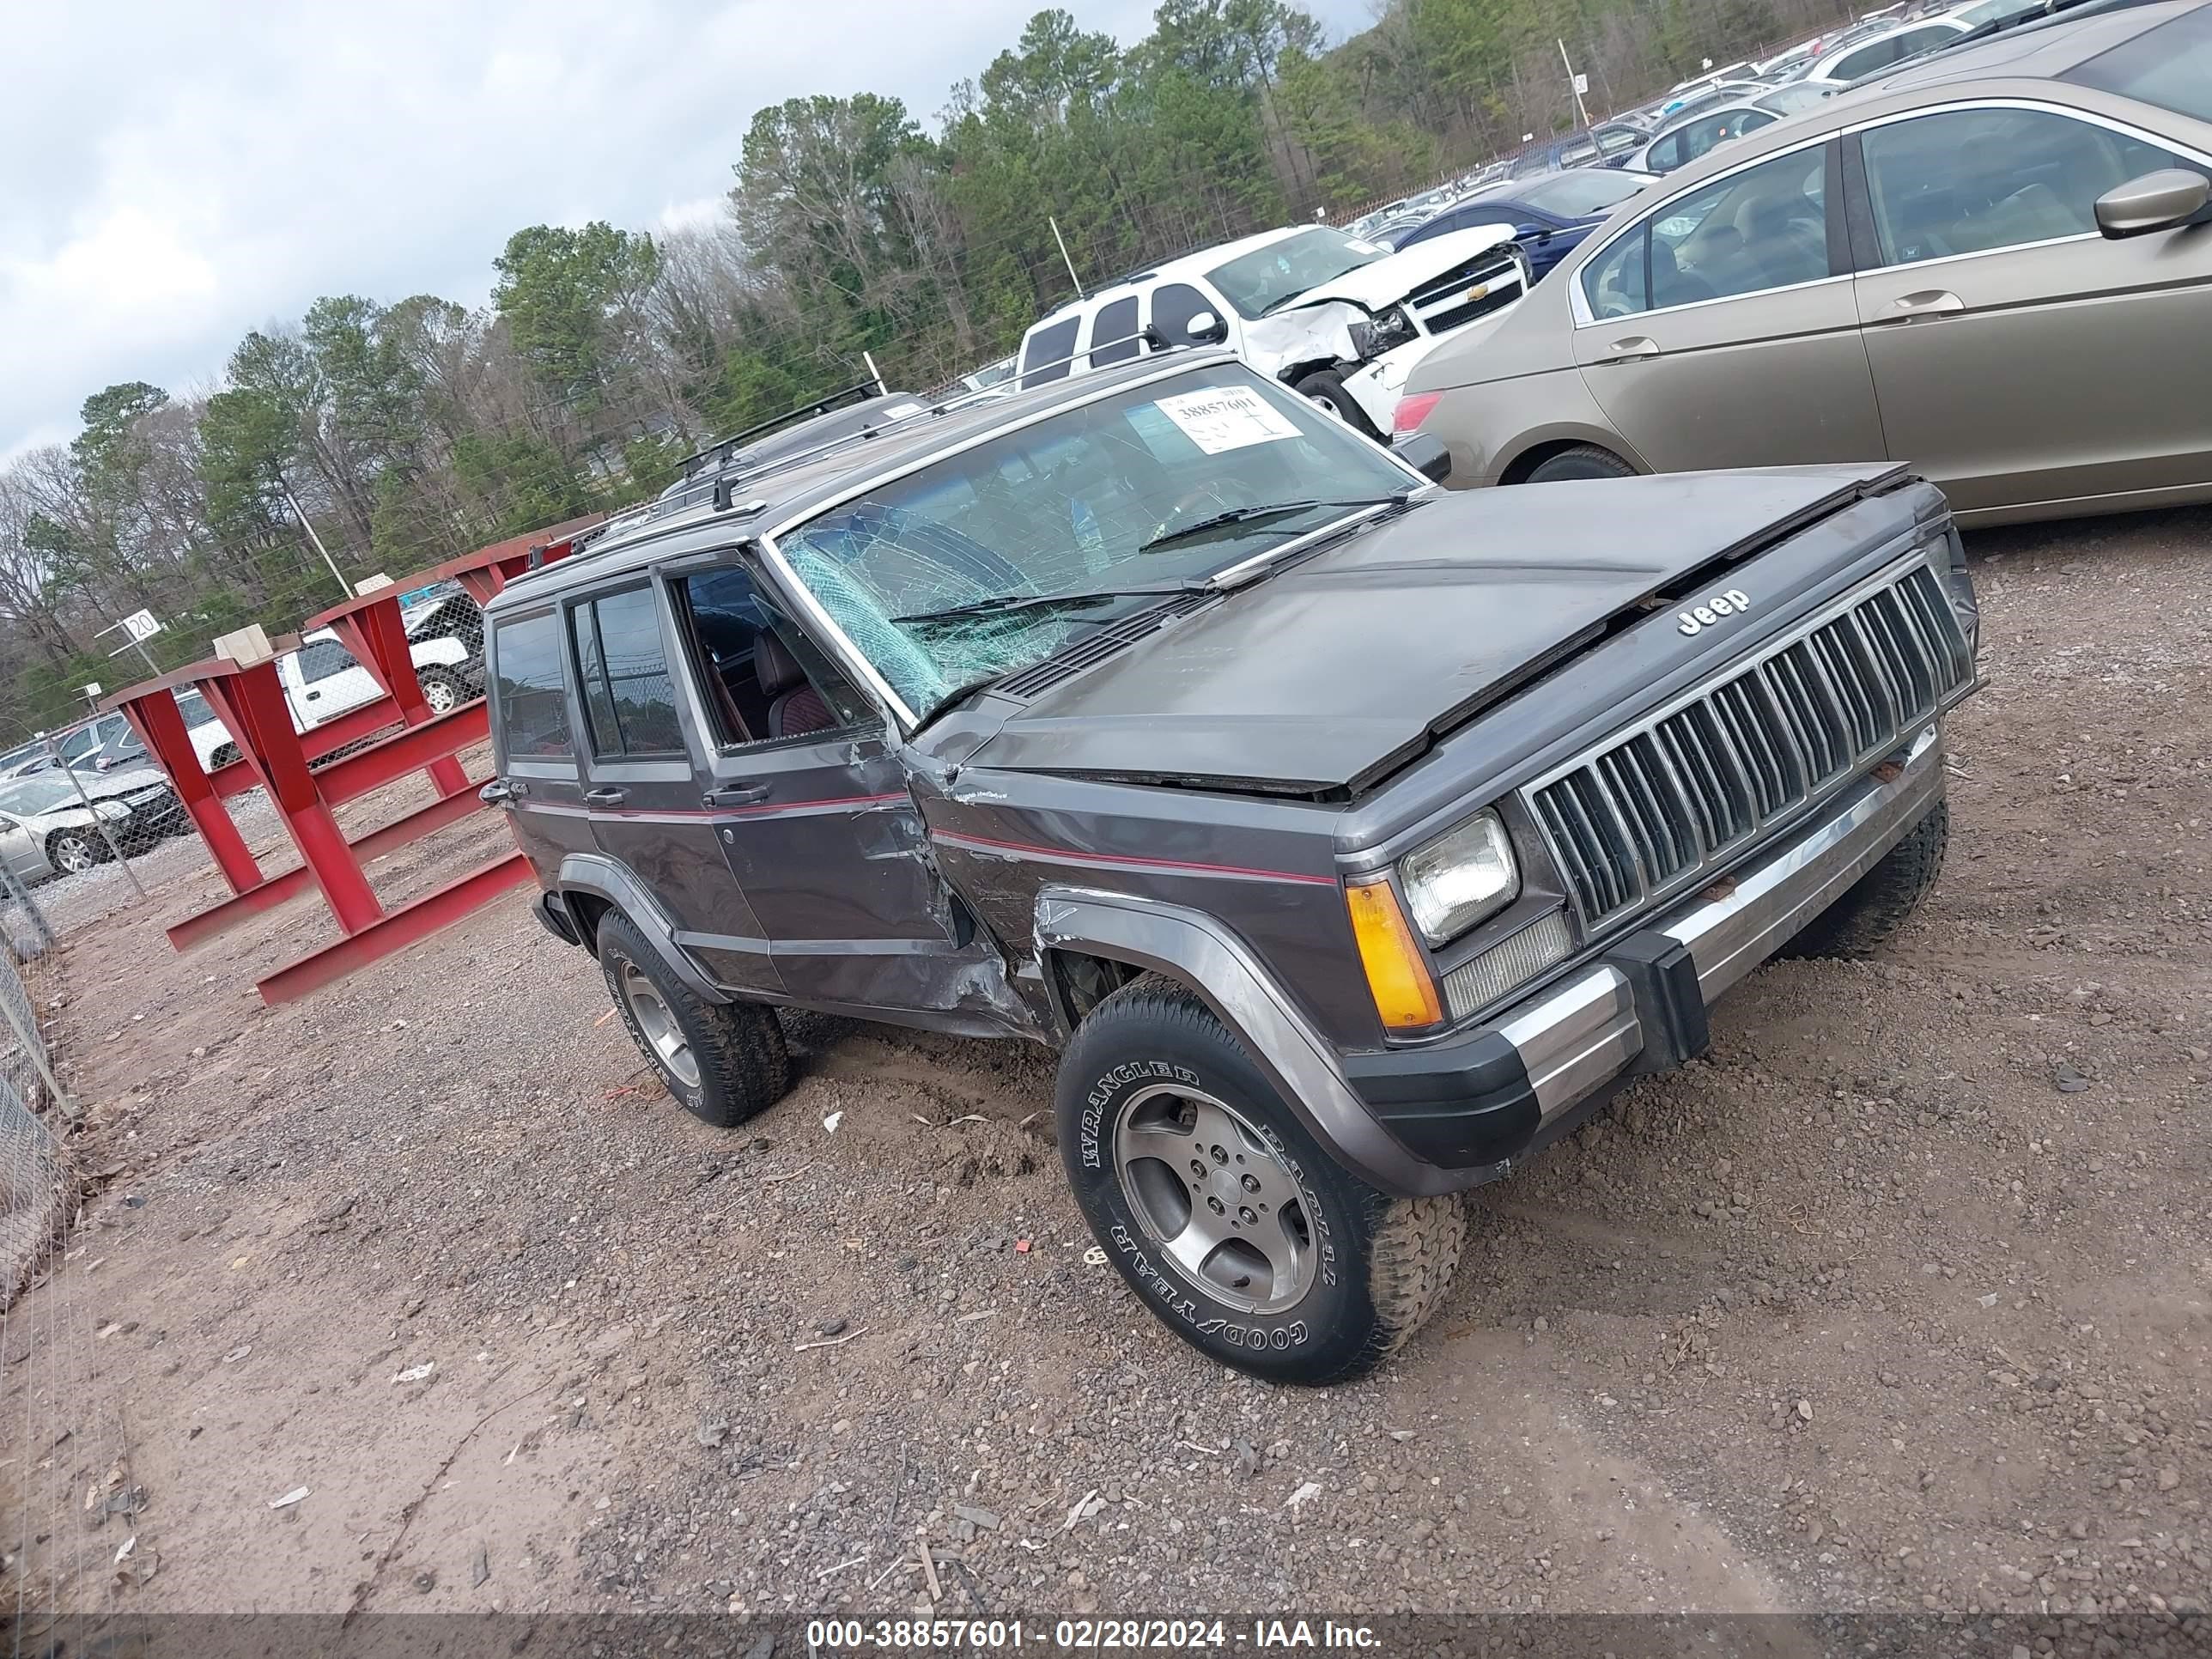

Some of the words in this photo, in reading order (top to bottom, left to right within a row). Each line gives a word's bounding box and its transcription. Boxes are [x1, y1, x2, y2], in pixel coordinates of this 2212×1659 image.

[1177, 398, 1257, 420] 38857601
[129, 615, 154, 636] 20
[1678, 589, 1750, 635] Jeep
[89, 684, 100, 694] 20
[1081, 1061, 1200, 1168] WRANGLER
[1110, 1225, 1309, 1351] GOODYEAR
